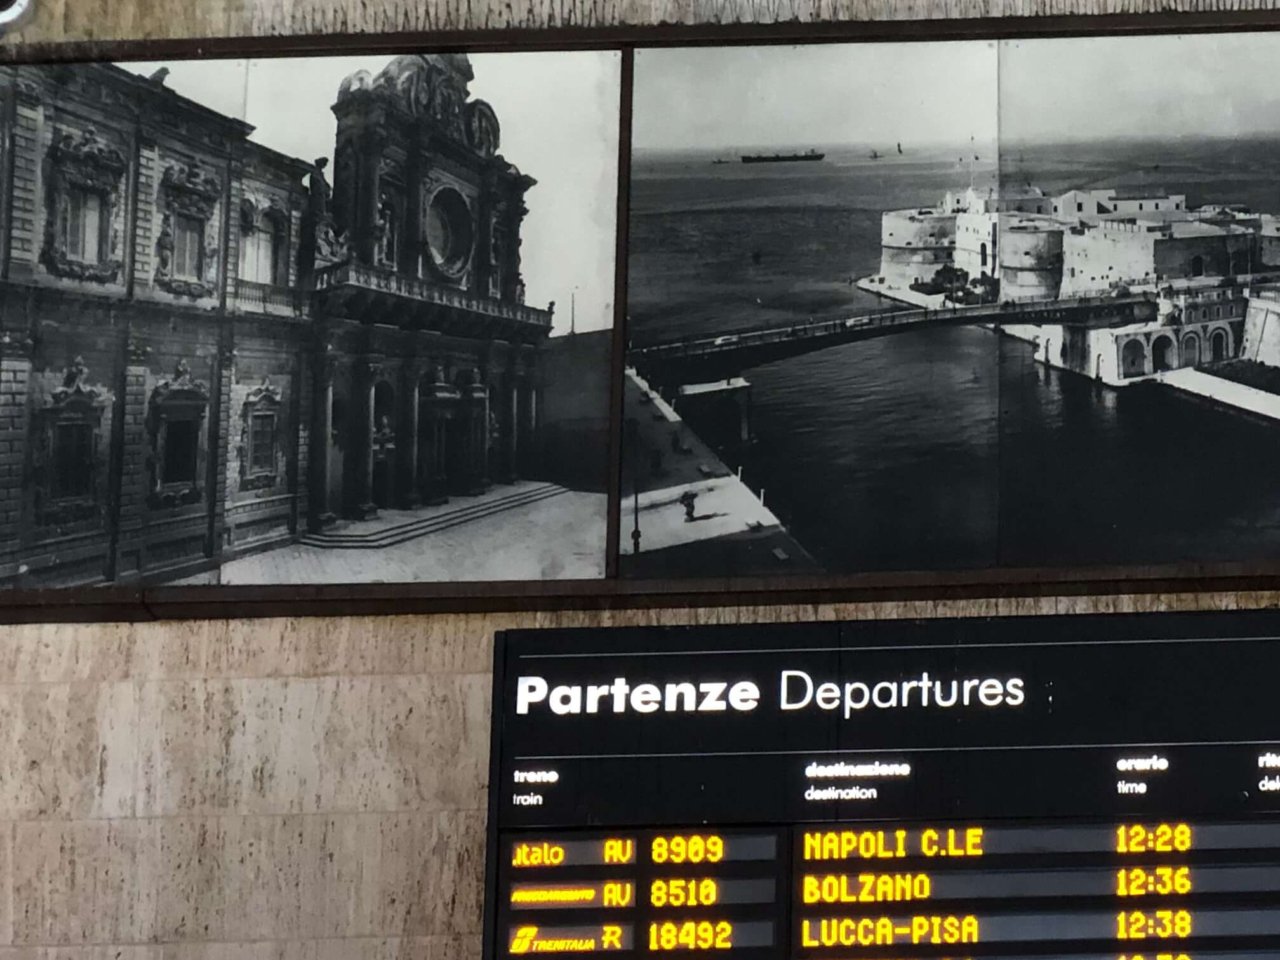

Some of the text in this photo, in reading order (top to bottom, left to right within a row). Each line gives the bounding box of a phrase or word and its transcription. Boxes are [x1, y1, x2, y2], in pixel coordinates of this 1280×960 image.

[516, 669, 1025, 720] Partenze Departures
[804, 784, 878, 801] destination
[1116, 779, 1148, 794] time
[652, 835, 723, 863] 8909
[805, 830, 906, 860] NAPOLI
[921, 828, 983, 856] C.LE
[1116, 824, 1191, 853] 12:28
[651, 879, 717, 907] 8510
[803, 874, 930, 903] BOLZANO
[1117, 867, 1191, 896] 12:36
[649, 921, 732, 950] 18492
[803, 915, 978, 947] LUCCA-PISA
[1117, 910, 1191, 939] 12:38
